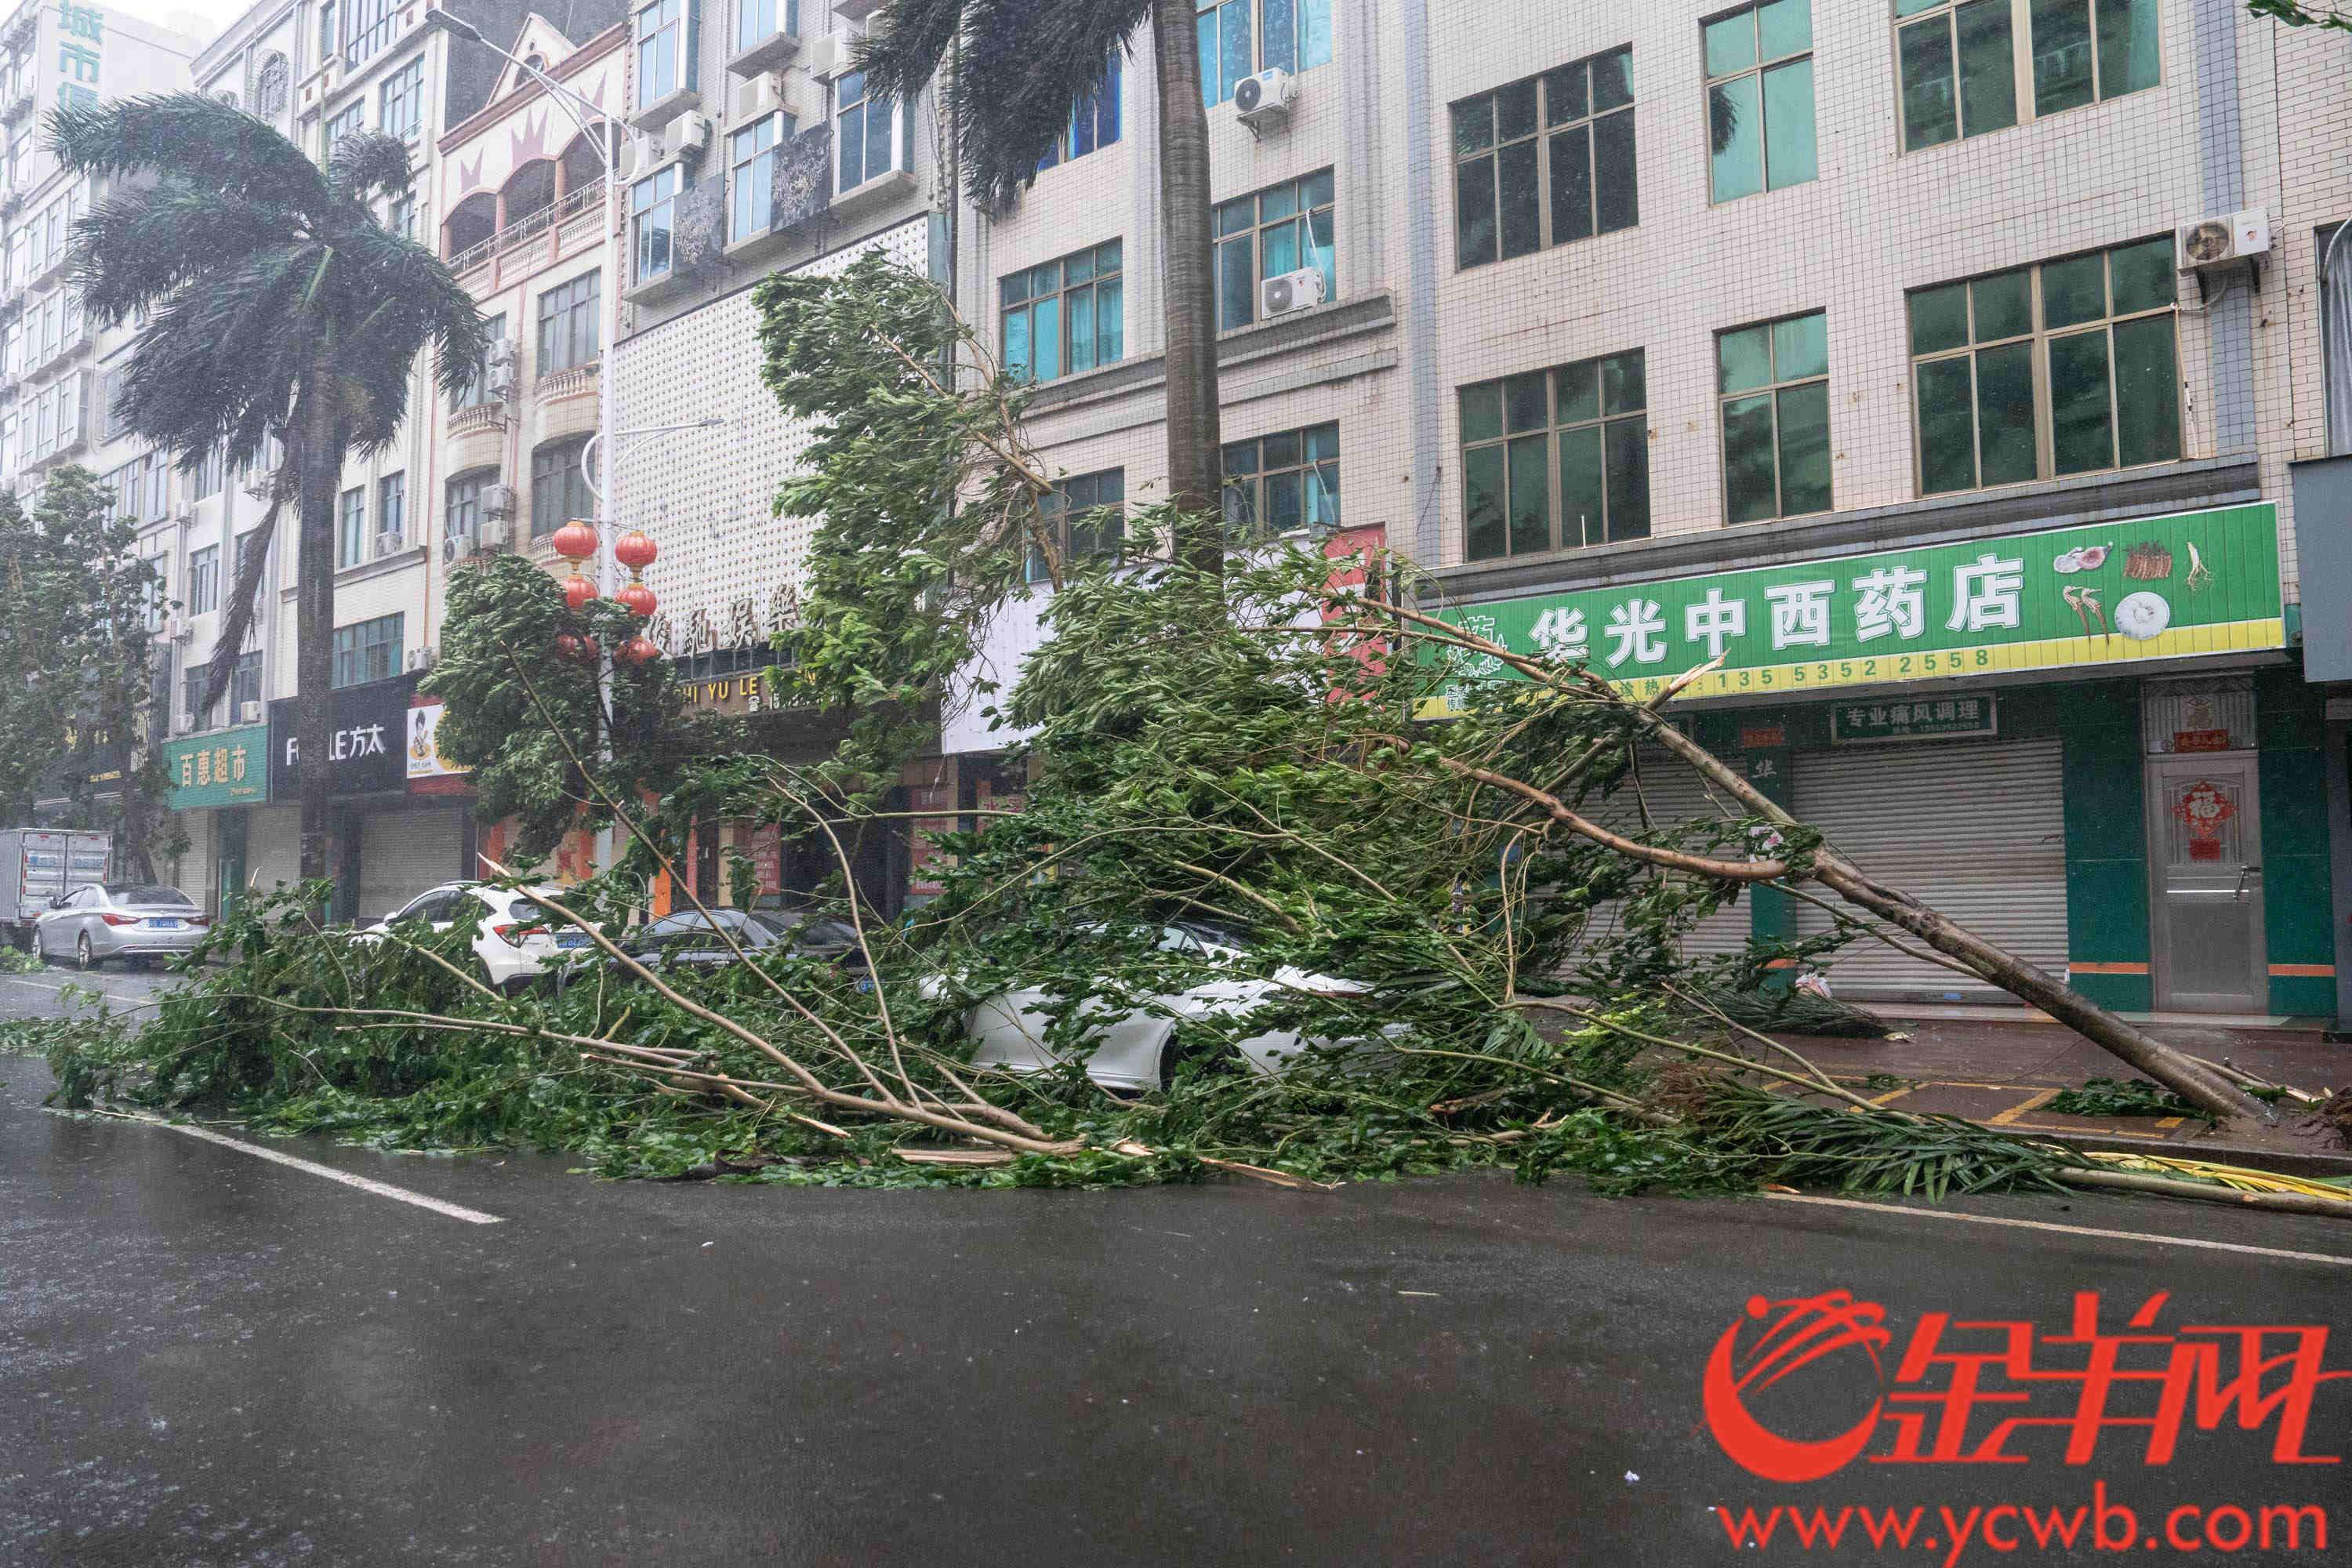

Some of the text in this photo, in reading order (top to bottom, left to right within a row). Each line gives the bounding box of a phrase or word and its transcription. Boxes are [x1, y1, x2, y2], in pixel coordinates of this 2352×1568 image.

[1529, 554, 2024, 669] 华光中西药店
[1718, 669, 1773, 688] 135
[1794, 659, 1876, 682] 5352
[1900, 649, 1989, 673] 2558
[708, 681, 728, 700] YU
[740, 677, 758, 696] LE
[1847, 700, 1980, 728] 专业痛风调理
[350, 724, 387, 758] 方太
[180, 743, 247, 787] 百惠超市
